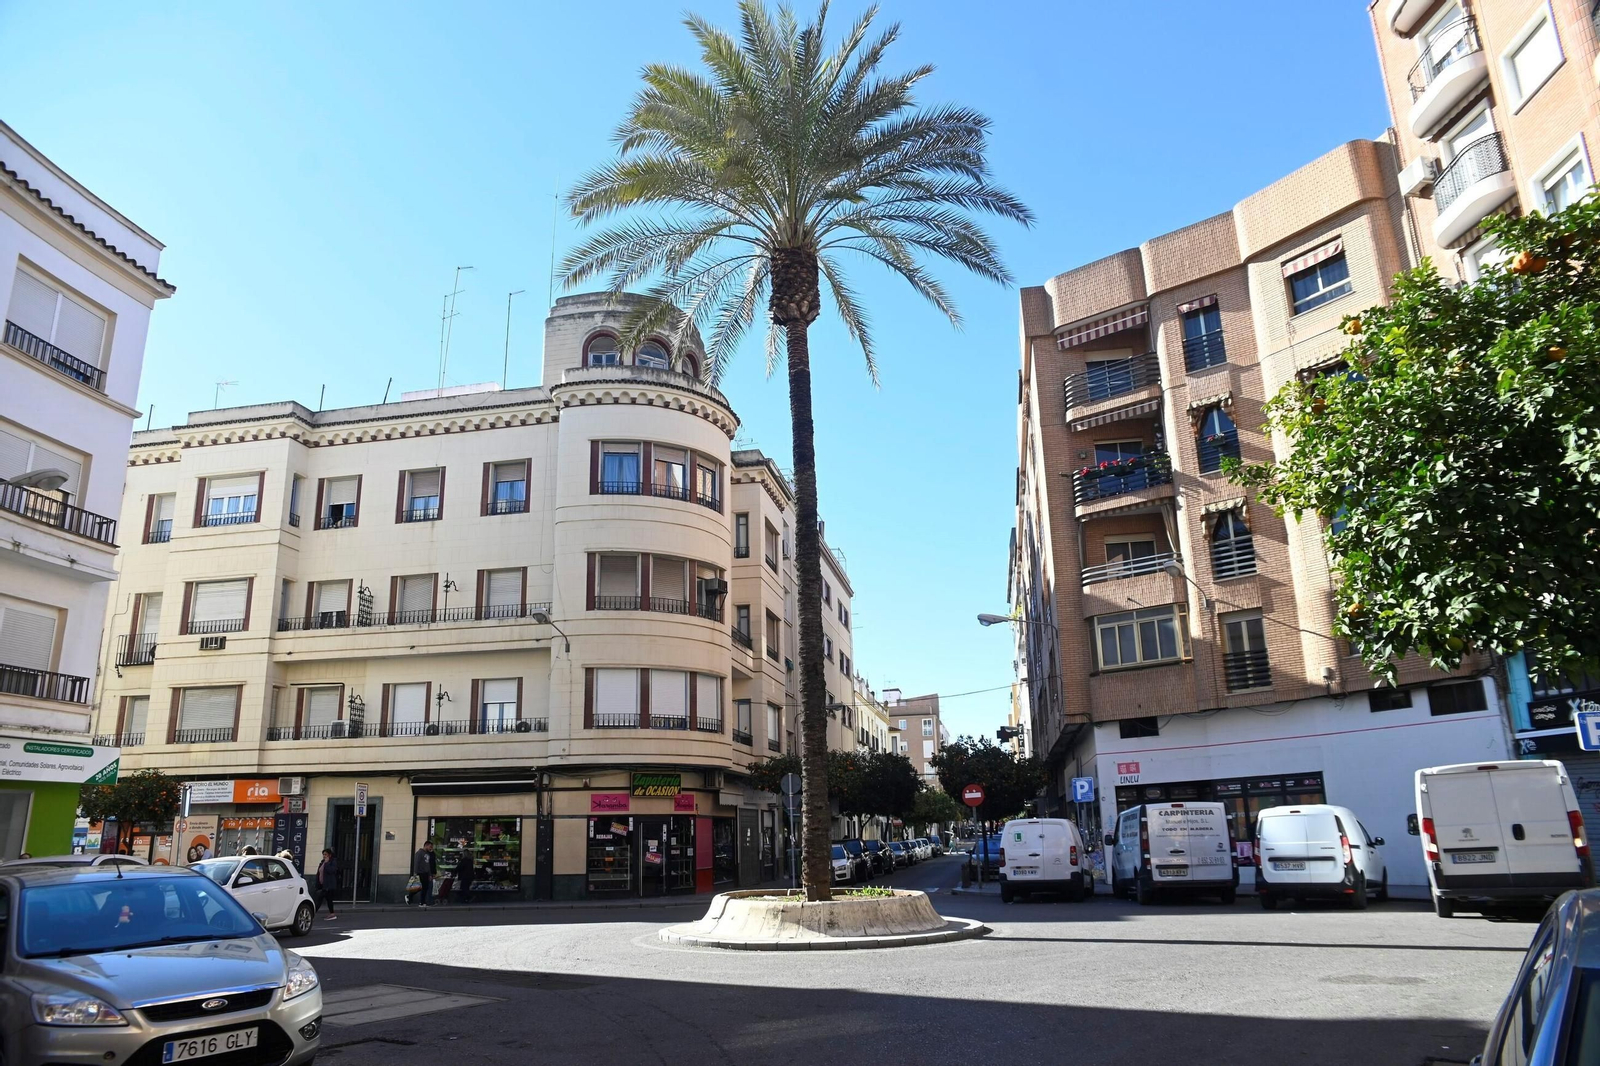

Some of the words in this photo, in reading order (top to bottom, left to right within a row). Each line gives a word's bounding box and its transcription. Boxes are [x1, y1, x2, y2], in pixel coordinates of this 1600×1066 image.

[26, 745, 60, 753] INSTALADORES
[9, 760, 39, 769] Comunidades
[102, 762, 117, 776] AÑOS
[633, 774, 680, 787] Zapatería
[247, 783, 268, 797] ria
[634, 787, 644, 796] de
[1076, 781, 1089, 800] P
[178, 1038, 217, 1058] 7616
[226, 1030, 253, 1049] GLY
